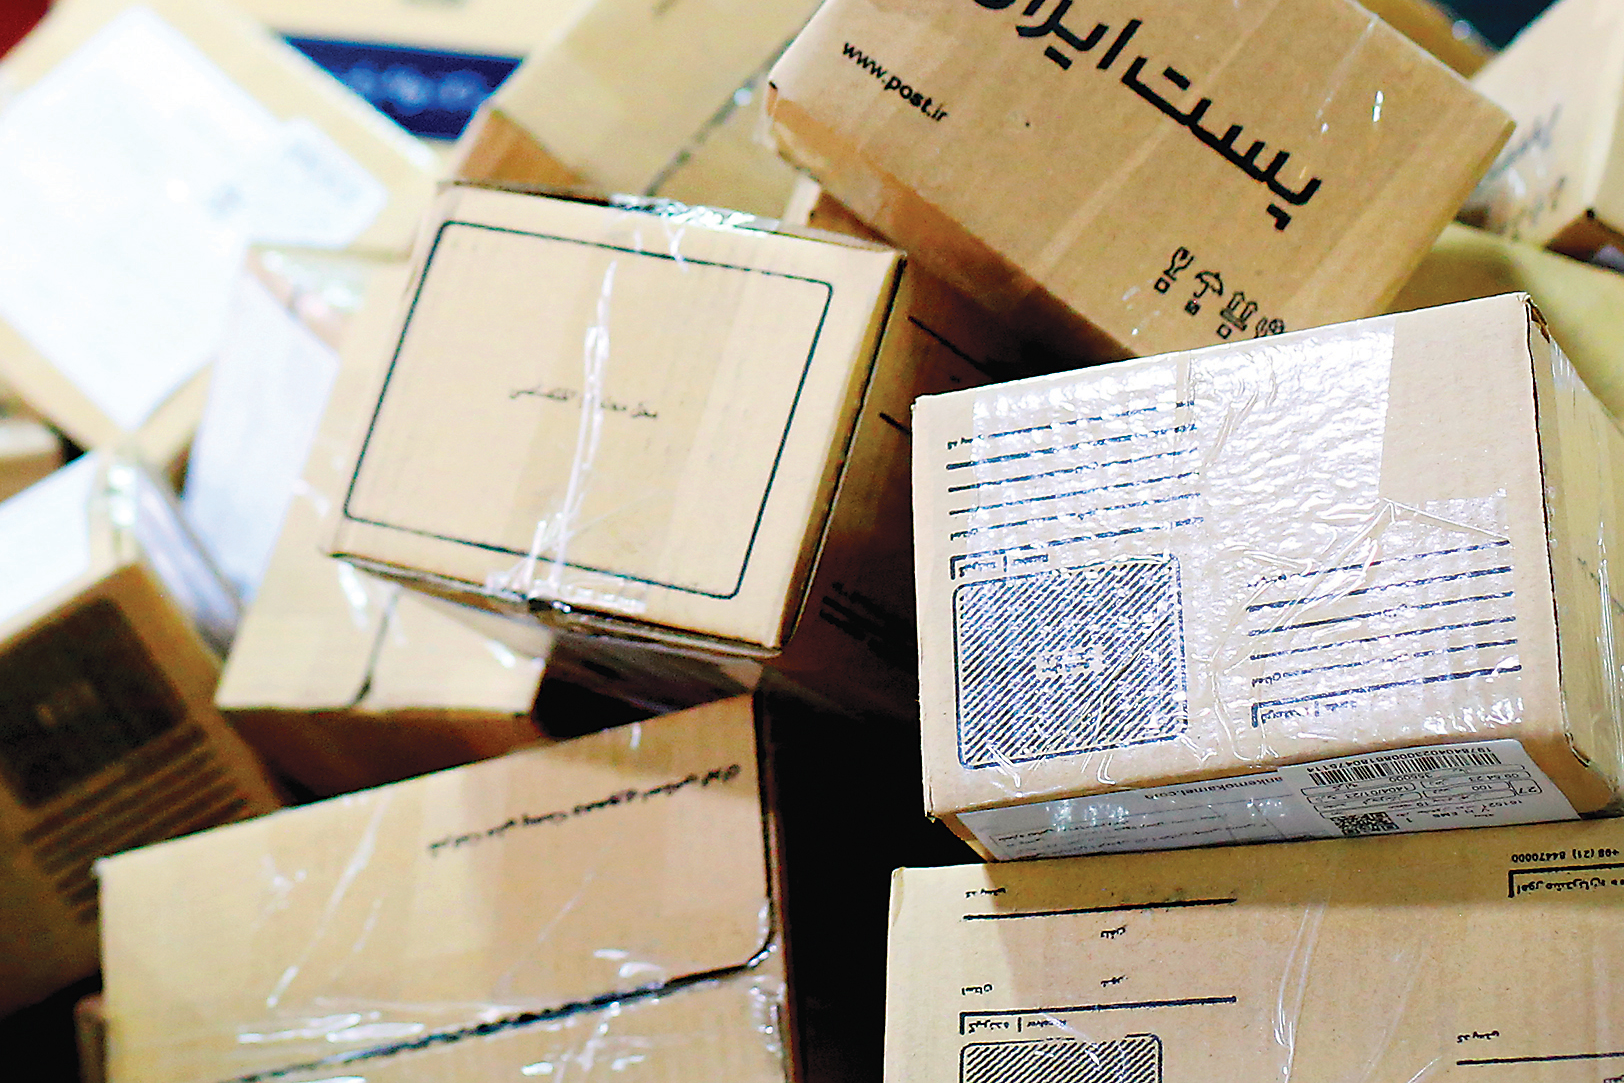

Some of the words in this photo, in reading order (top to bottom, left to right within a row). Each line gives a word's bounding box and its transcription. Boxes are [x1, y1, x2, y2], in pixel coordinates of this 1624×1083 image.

[842, 40, 949, 123] www.post.ir
[1120, 56, 1323, 232] پست
[1519, 785, 1538, 795] 27
[1510, 850, 1566, 863] 84470000
[1572, 847, 1595, 860] (21)
[1517, 880, 1544, 895] امور
[1100, 925, 1127, 940] تلفن
[961, 983, 994, 996] استان
[968, 1019, 1010, 1034] گیرنده
